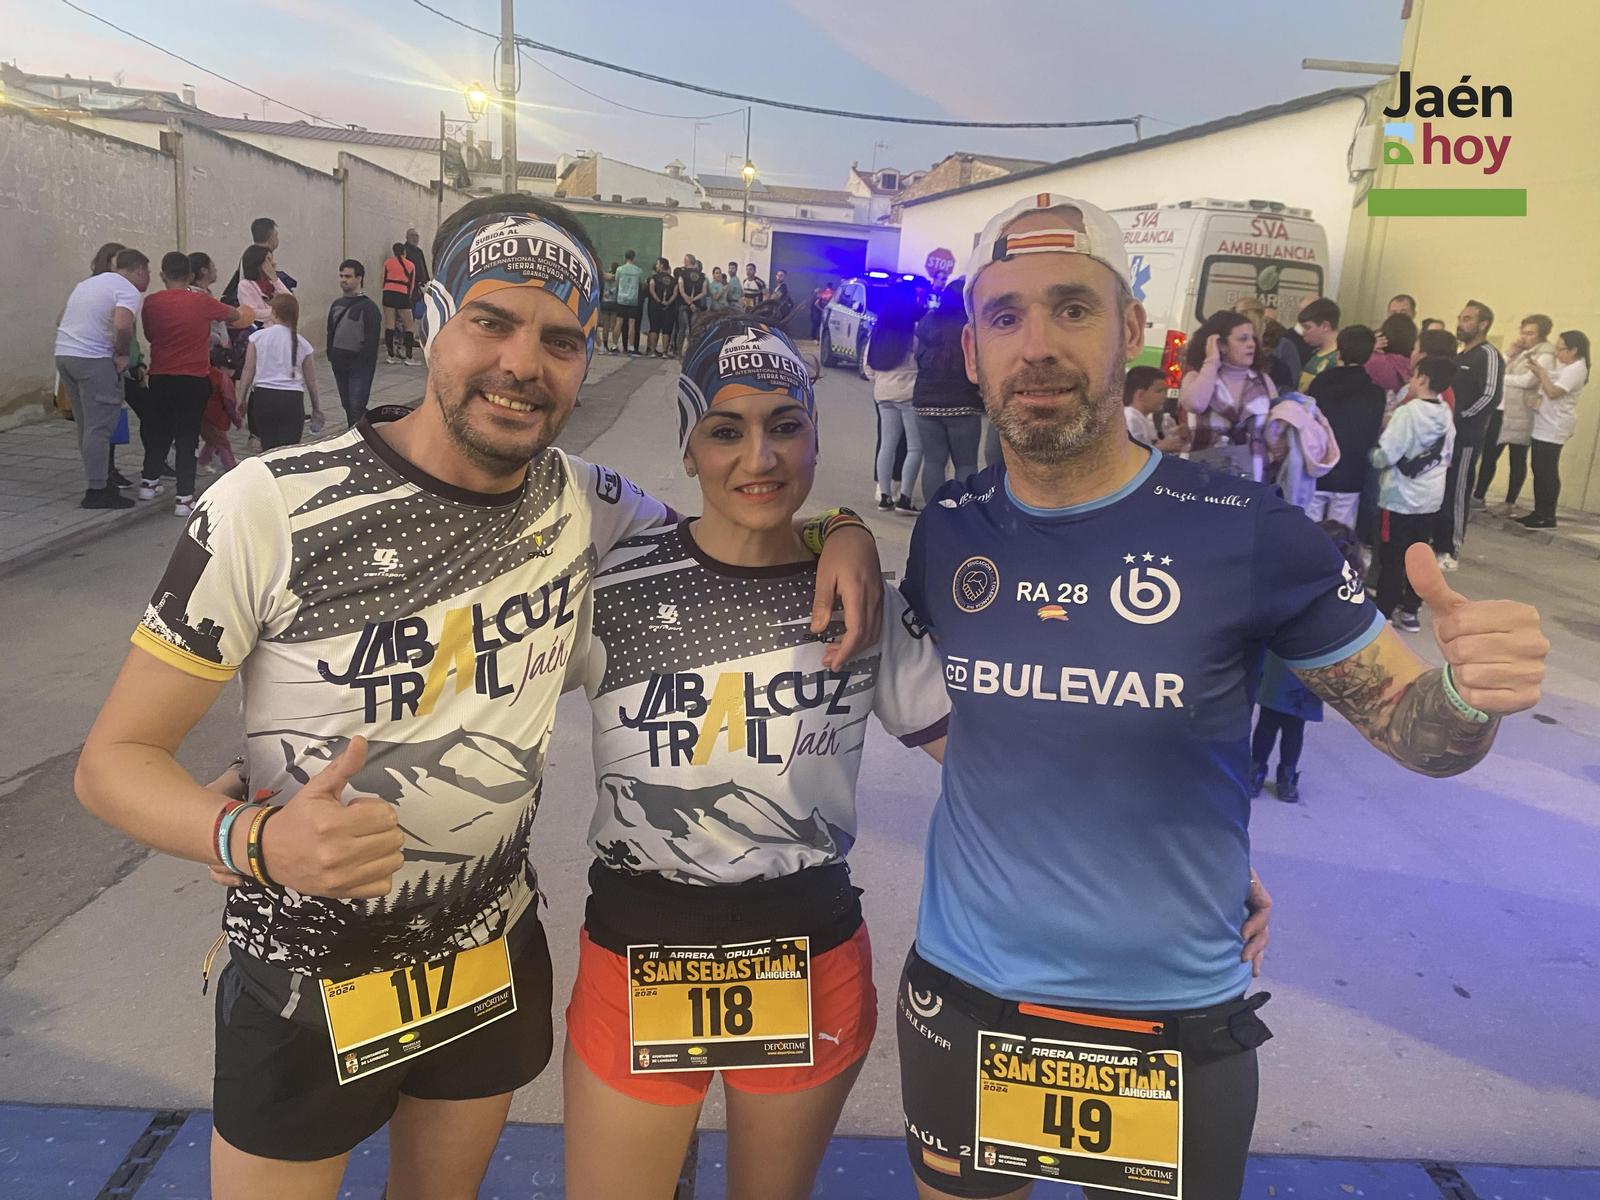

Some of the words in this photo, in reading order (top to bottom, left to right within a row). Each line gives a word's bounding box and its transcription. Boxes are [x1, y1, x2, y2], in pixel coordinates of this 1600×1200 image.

[1131, 211, 1160, 228] SVA
[1251, 218, 1289, 240] SVA
[475, 230, 505, 247] SUBIDA
[1122, 231, 1175, 244] BULANCIA
[1217, 240, 1316, 261] AMBULANCIA
[469, 238, 518, 273] PICO
[527, 238, 592, 299] VELETA
[483, 256, 536, 270] INTERNATIONAL
[537, 257, 570, 277] MOUNTAIN
[507, 262, 535, 270] SIERRA
[536, 263, 564, 281] NEVADA
[927, 256, 954, 271] STOP
[522, 270, 549, 280] GRANADA
[724, 344, 750, 354] SUBIDA
[719, 353, 763, 374] PICO
[1154, 485, 1199, 502] grazie
[1204, 494, 1251, 507] mille!
[1016, 581, 1050, 602] RA
[1057, 583, 1089, 604] 28
[317, 574, 574, 686] JABALCUZ
[508, 635, 568, 707] Jaén
[946, 664, 968, 683] CD
[973, 660, 1184, 708] BULEVAR
[619, 671, 852, 729] JABALCUZ
[777, 720, 841, 776] Jaén
[649, 951, 659, 959] III
[669, 951, 715, 960] ARRERA
[724, 947, 772, 959] OPULAR
[642, 960, 682, 983] SAN
[755, 970, 802, 980] LAHIGUERA
[329, 985, 356, 998] 2024
[390, 951, 457, 1025] 117
[634, 990, 658, 998] 2024
[687, 985, 754, 1037] 118
[905, 1008, 952, 1051] BULEVAR
[764, 1041, 806, 1051] DEPORTIME
[1001, 1043, 1012, 1053] III
[1014, 1045, 1074, 1061] CRRERA
[1079, 1052, 1138, 1066] POPULAR
[993, 1053, 1036, 1083] SAN
[983, 1085, 1008, 1093] 2024
[1118, 1086, 1172, 1100] LAHIGUERA
[1042, 1093, 1113, 1154] 49
[1124, 1166, 1174, 1180] DEPORTIME
